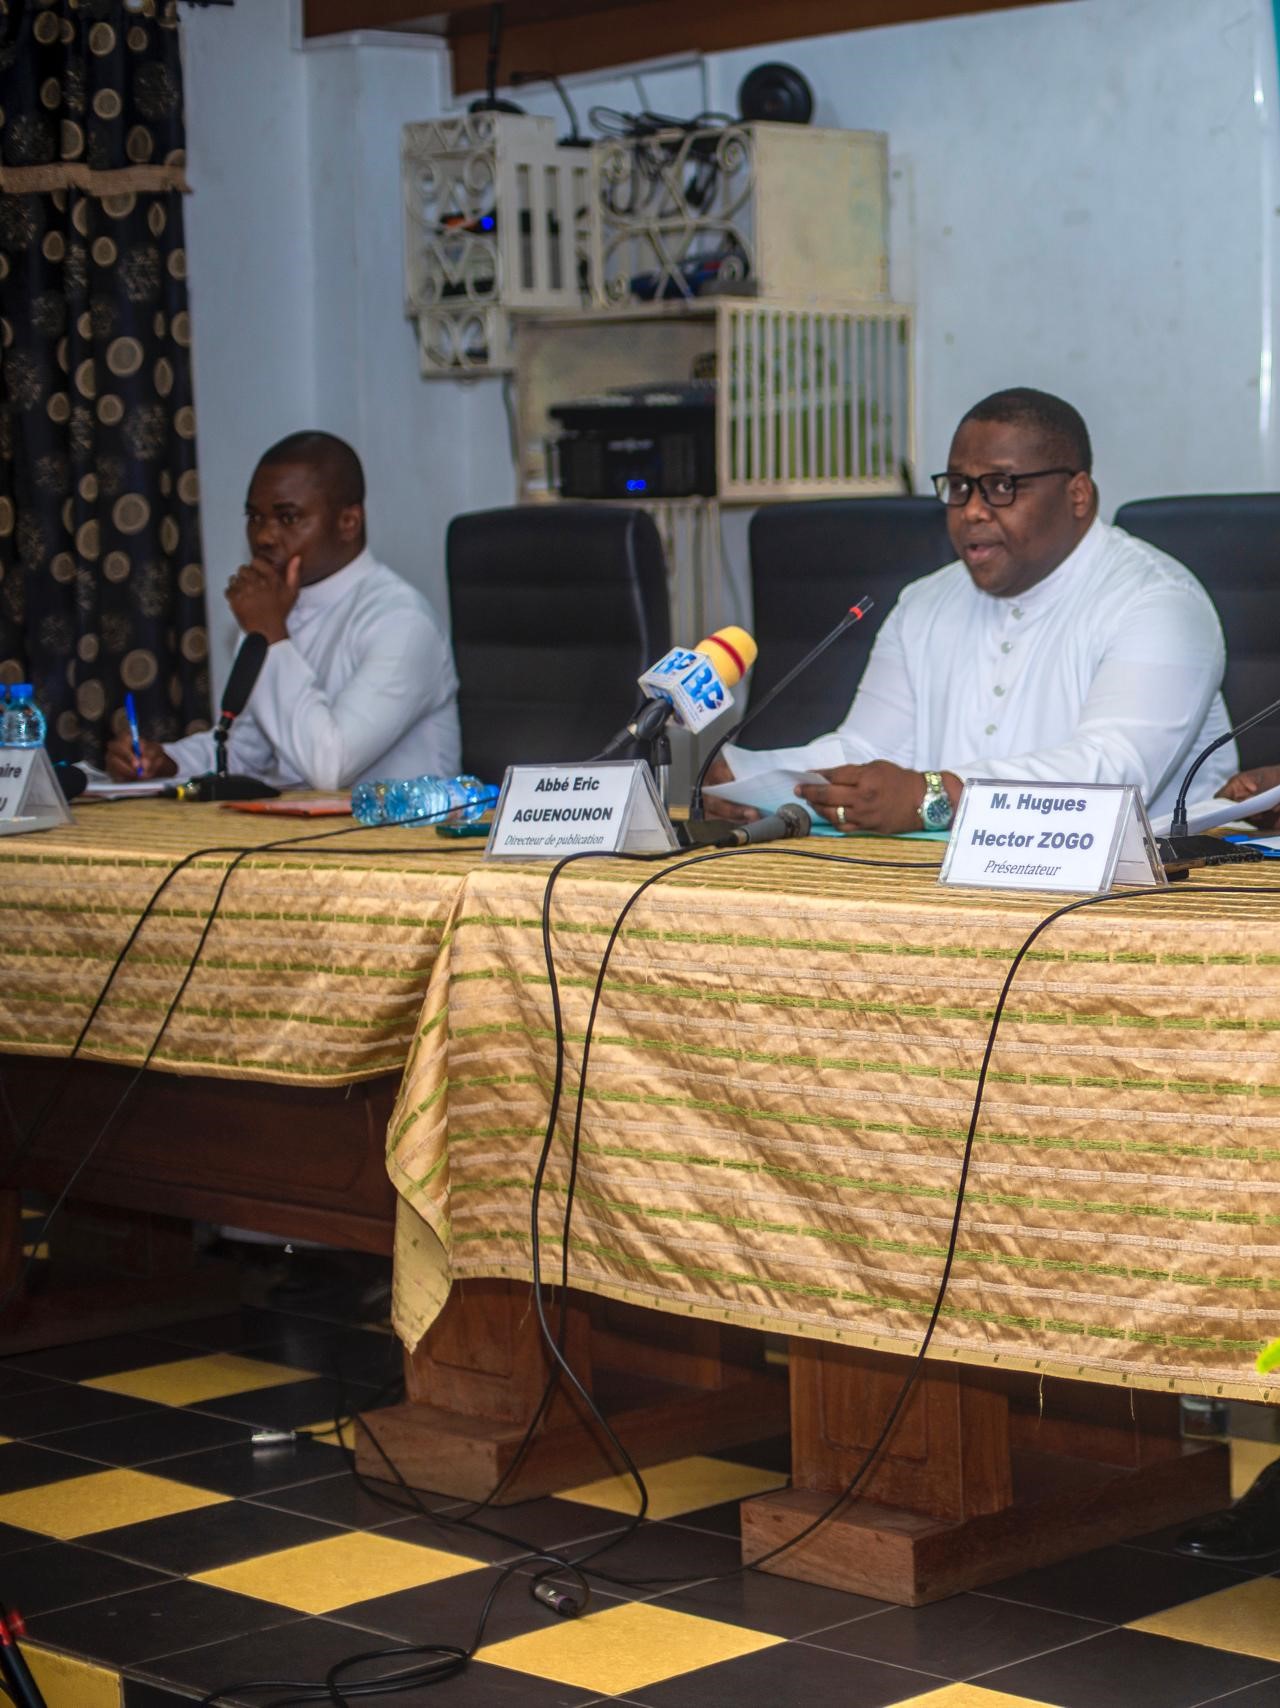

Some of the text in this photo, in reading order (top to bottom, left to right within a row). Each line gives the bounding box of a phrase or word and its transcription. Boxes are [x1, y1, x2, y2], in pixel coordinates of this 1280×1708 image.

[534, 776, 600, 793] Abbé Eric
[990, 792, 1088, 815] M. Hugues
[512, 807, 613, 823] AGUENOUNON
[504, 833, 605, 849] Directeur de publication
[970, 829, 1095, 850] Hector ZOGO
[983, 859, 1062, 877] Présentateur
